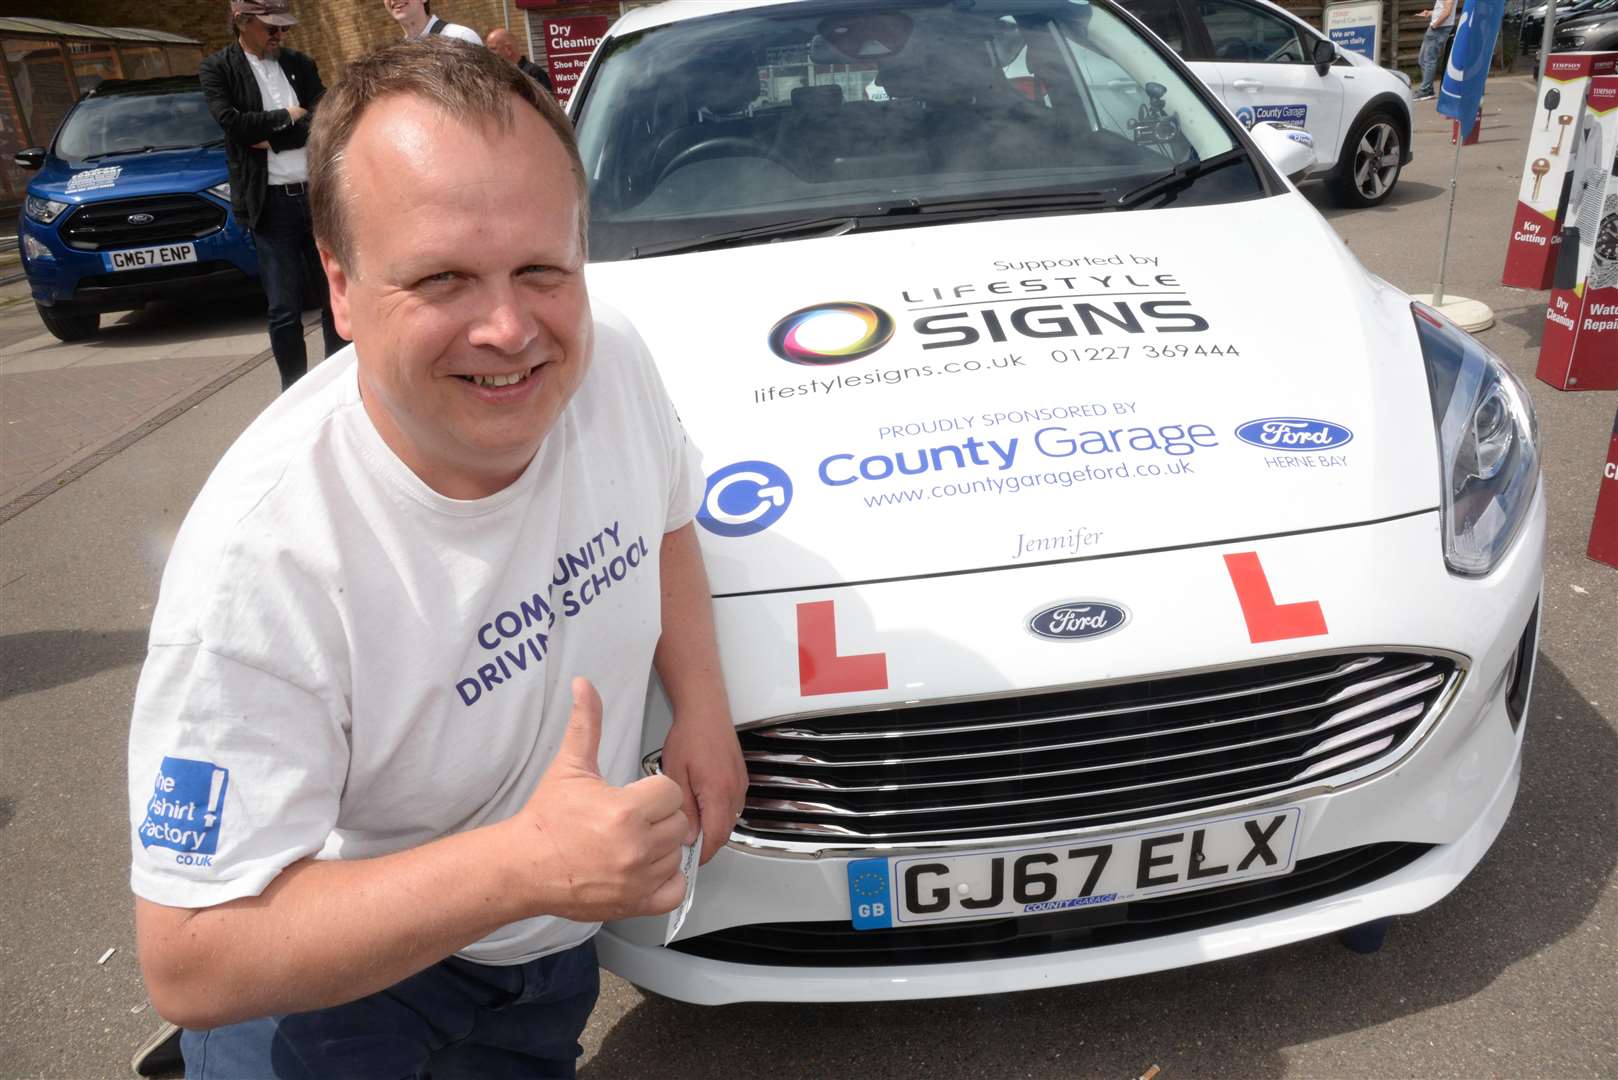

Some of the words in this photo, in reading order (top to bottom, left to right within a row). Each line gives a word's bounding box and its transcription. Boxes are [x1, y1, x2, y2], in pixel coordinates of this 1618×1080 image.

[549, 23, 571, 37] Dry
[553, 61, 573, 69] Shoe
[557, 87, 572, 95] Key
[1256, 108, 1281, 119] County
[1282, 107, 1306, 118] Garage
[1514, 231, 1546, 246] Cutting
[1523, 221, 1541, 233] Key
[113, 249, 155, 268] GM67
[160, 245, 191, 262] ENP
[993, 254, 1123, 272] Supported
[1130, 253, 1160, 267] by
[901, 274, 1181, 303] LIFESTYLE
[1556, 296, 1569, 313] Dry
[913, 300, 1210, 350] SIGNS
[1546, 308, 1575, 331] Cleaning
[754, 353, 1027, 403] lifestylesigns.co.uk
[1051, 346, 1131, 364] 01227
[1142, 344, 1241, 358] 369444
[878, 415, 976, 440] PROUDLY
[982, 402, 1108, 427] SPONSORED
[1112, 401, 1138, 415] BY
[1260, 422, 1333, 444] Ford
[817, 436, 1019, 487] County
[1034, 423, 1220, 458] Garage
[1264, 455, 1317, 468] HERNE
[1318, 455, 1348, 467] BAY
[863, 458, 1195, 508] www.countygarageford.co.uk
[1011, 526, 1104, 559] Jennifer
[477, 521, 621, 650] COMUNITY
[562, 536, 649, 617] SCHOOL
[1222, 551, 1329, 643] L
[1049, 607, 1107, 633] Ford
[796, 600, 889, 697] L
[154, 771, 176, 793] he
[904, 844, 1114, 914] GJ67
[1136, 815, 1287, 890] ELX
[858, 903, 885, 917] GB
[1025, 900, 1071, 912] COUNTY
[1073, 893, 1118, 905] GARAGE
